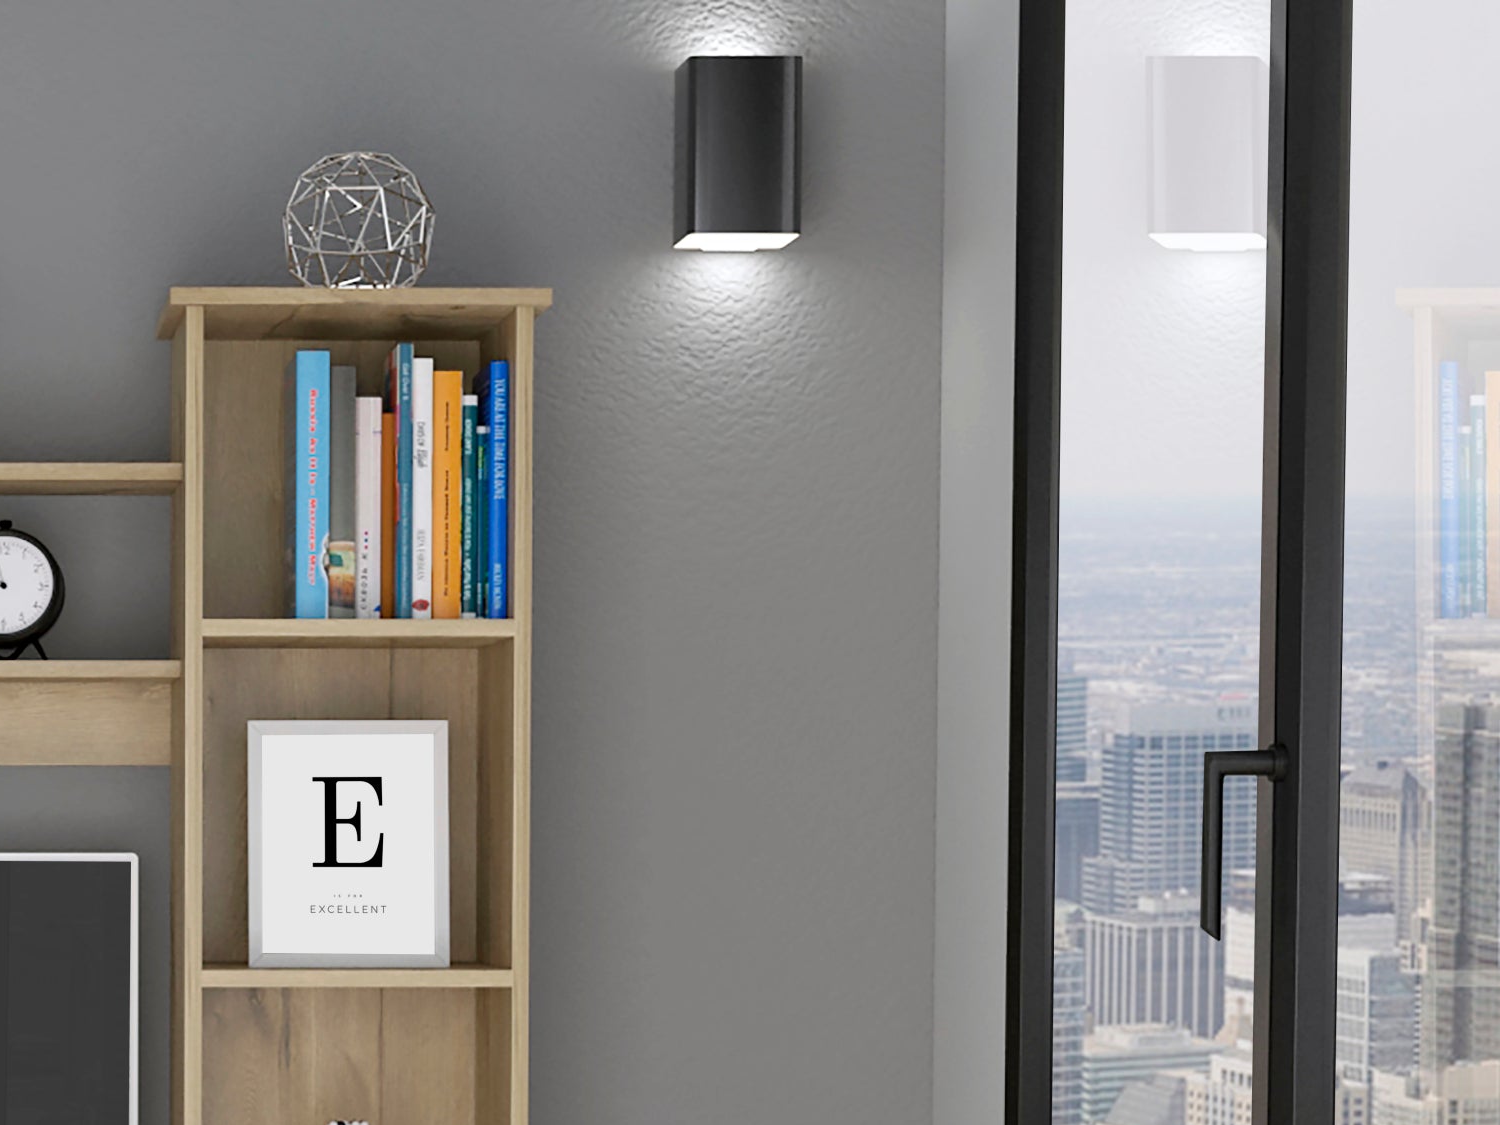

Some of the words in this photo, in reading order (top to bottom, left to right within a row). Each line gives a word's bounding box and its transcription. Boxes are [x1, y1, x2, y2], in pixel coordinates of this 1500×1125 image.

[402, 376, 410, 394] Over
[494, 378, 505, 396] YOU
[308, 389, 318, 432] Russia
[494, 397, 505, 411] ARE
[494, 413, 505, 423] AT
[494, 424, 505, 440] THE
[308, 438, 318, 454] As
[494, 442, 505, 461] TIME
[308, 457, 318, 469] It
[494, 463, 505, 478] FOR
[308, 472, 318, 485] Is
[494, 479, 505, 500] LOVE
[312, 777, 384, 868] E
[310, 905, 387, 914] EXCELLENT
